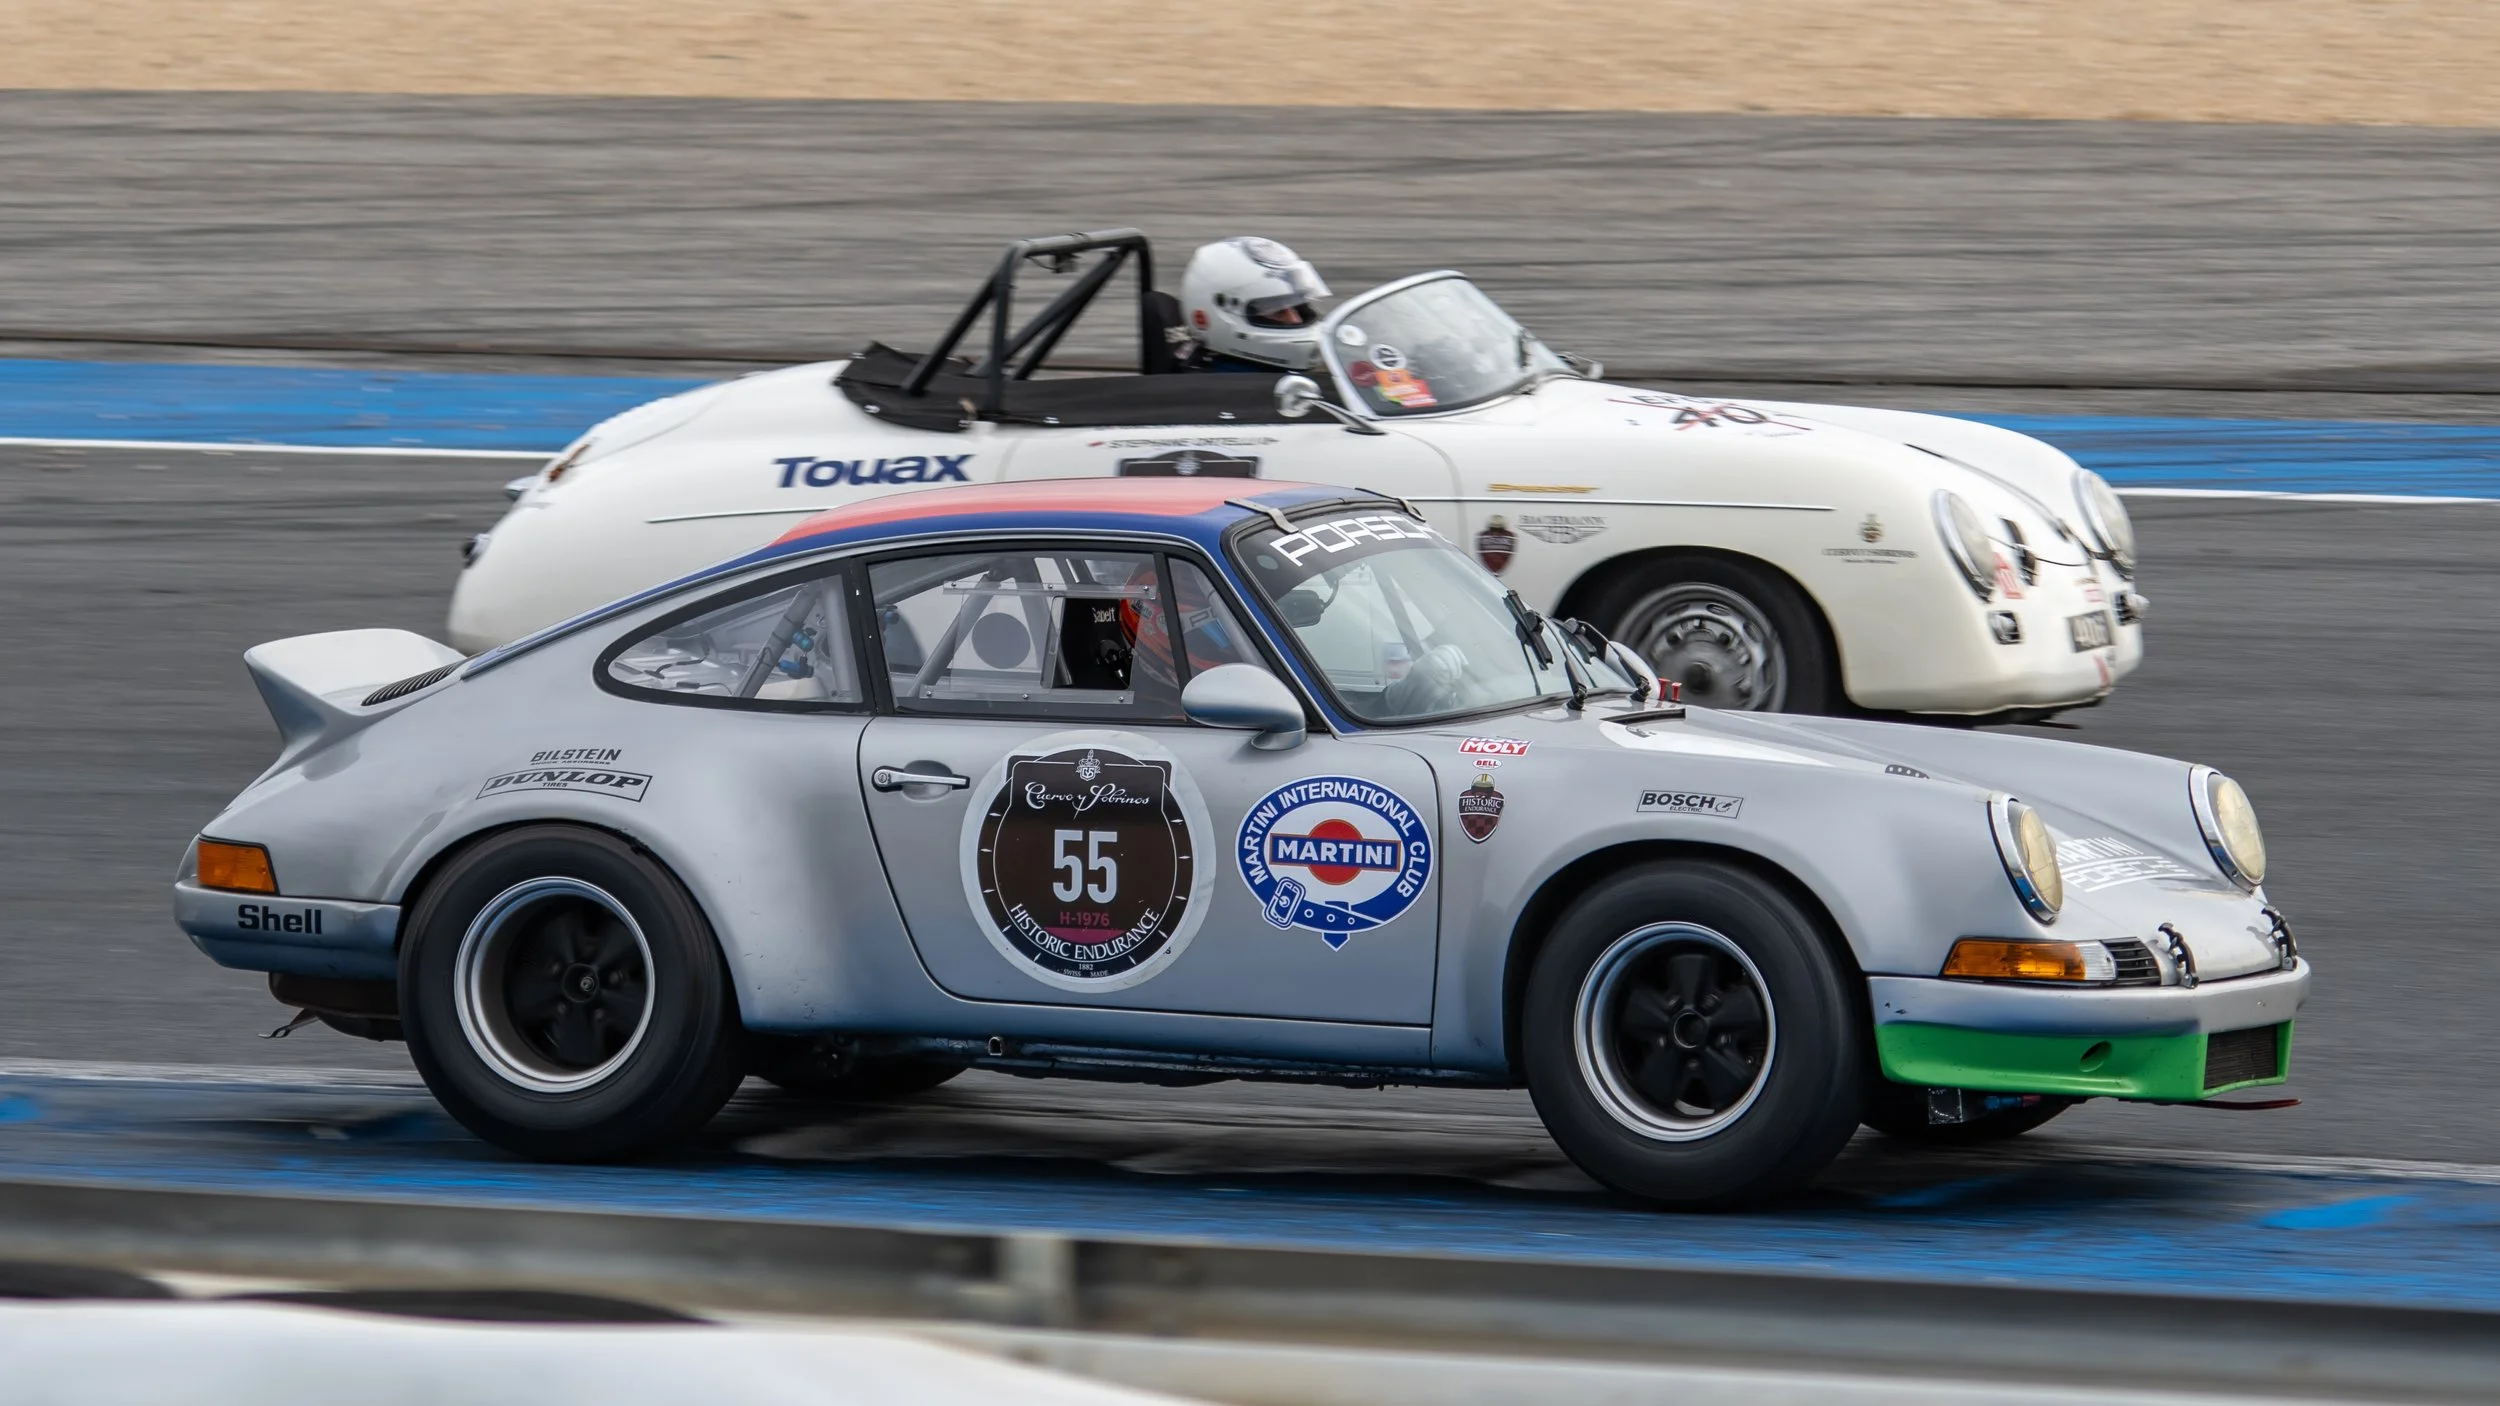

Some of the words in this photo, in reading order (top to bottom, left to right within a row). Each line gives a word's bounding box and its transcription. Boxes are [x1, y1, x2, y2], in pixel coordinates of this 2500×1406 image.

[772, 454, 976, 488] Touax
[530, 748, 622, 762] BILSTEIN
[1463, 741, 1526, 754] MOLY
[485, 771, 644, 791] DUNLOP
[1025, 781, 1074, 810] Cuervo
[1072, 783, 1149, 811] Sobrinos
[1462, 798, 1501, 809] HISTORIC
[1642, 793, 1716, 809] BOSCH
[1464, 806, 1498, 814] ENDURANCE
[1244, 801, 1280, 885] MARTINI
[1278, 781, 1416, 837] INTERNATIONAL
[1396, 841, 1425, 898] CLUB
[1277, 839, 1392, 866] MARTINI
[1052, 829, 1118, 904] 55
[237, 903, 323, 935] Shell
[1060, 911, 1110, 927] H-1976
[1010, 903, 1071, 957] HISTORIC
[1074, 908, 1160, 960] ENDURANCE
[1078, 963, 1094, 971] 1882
